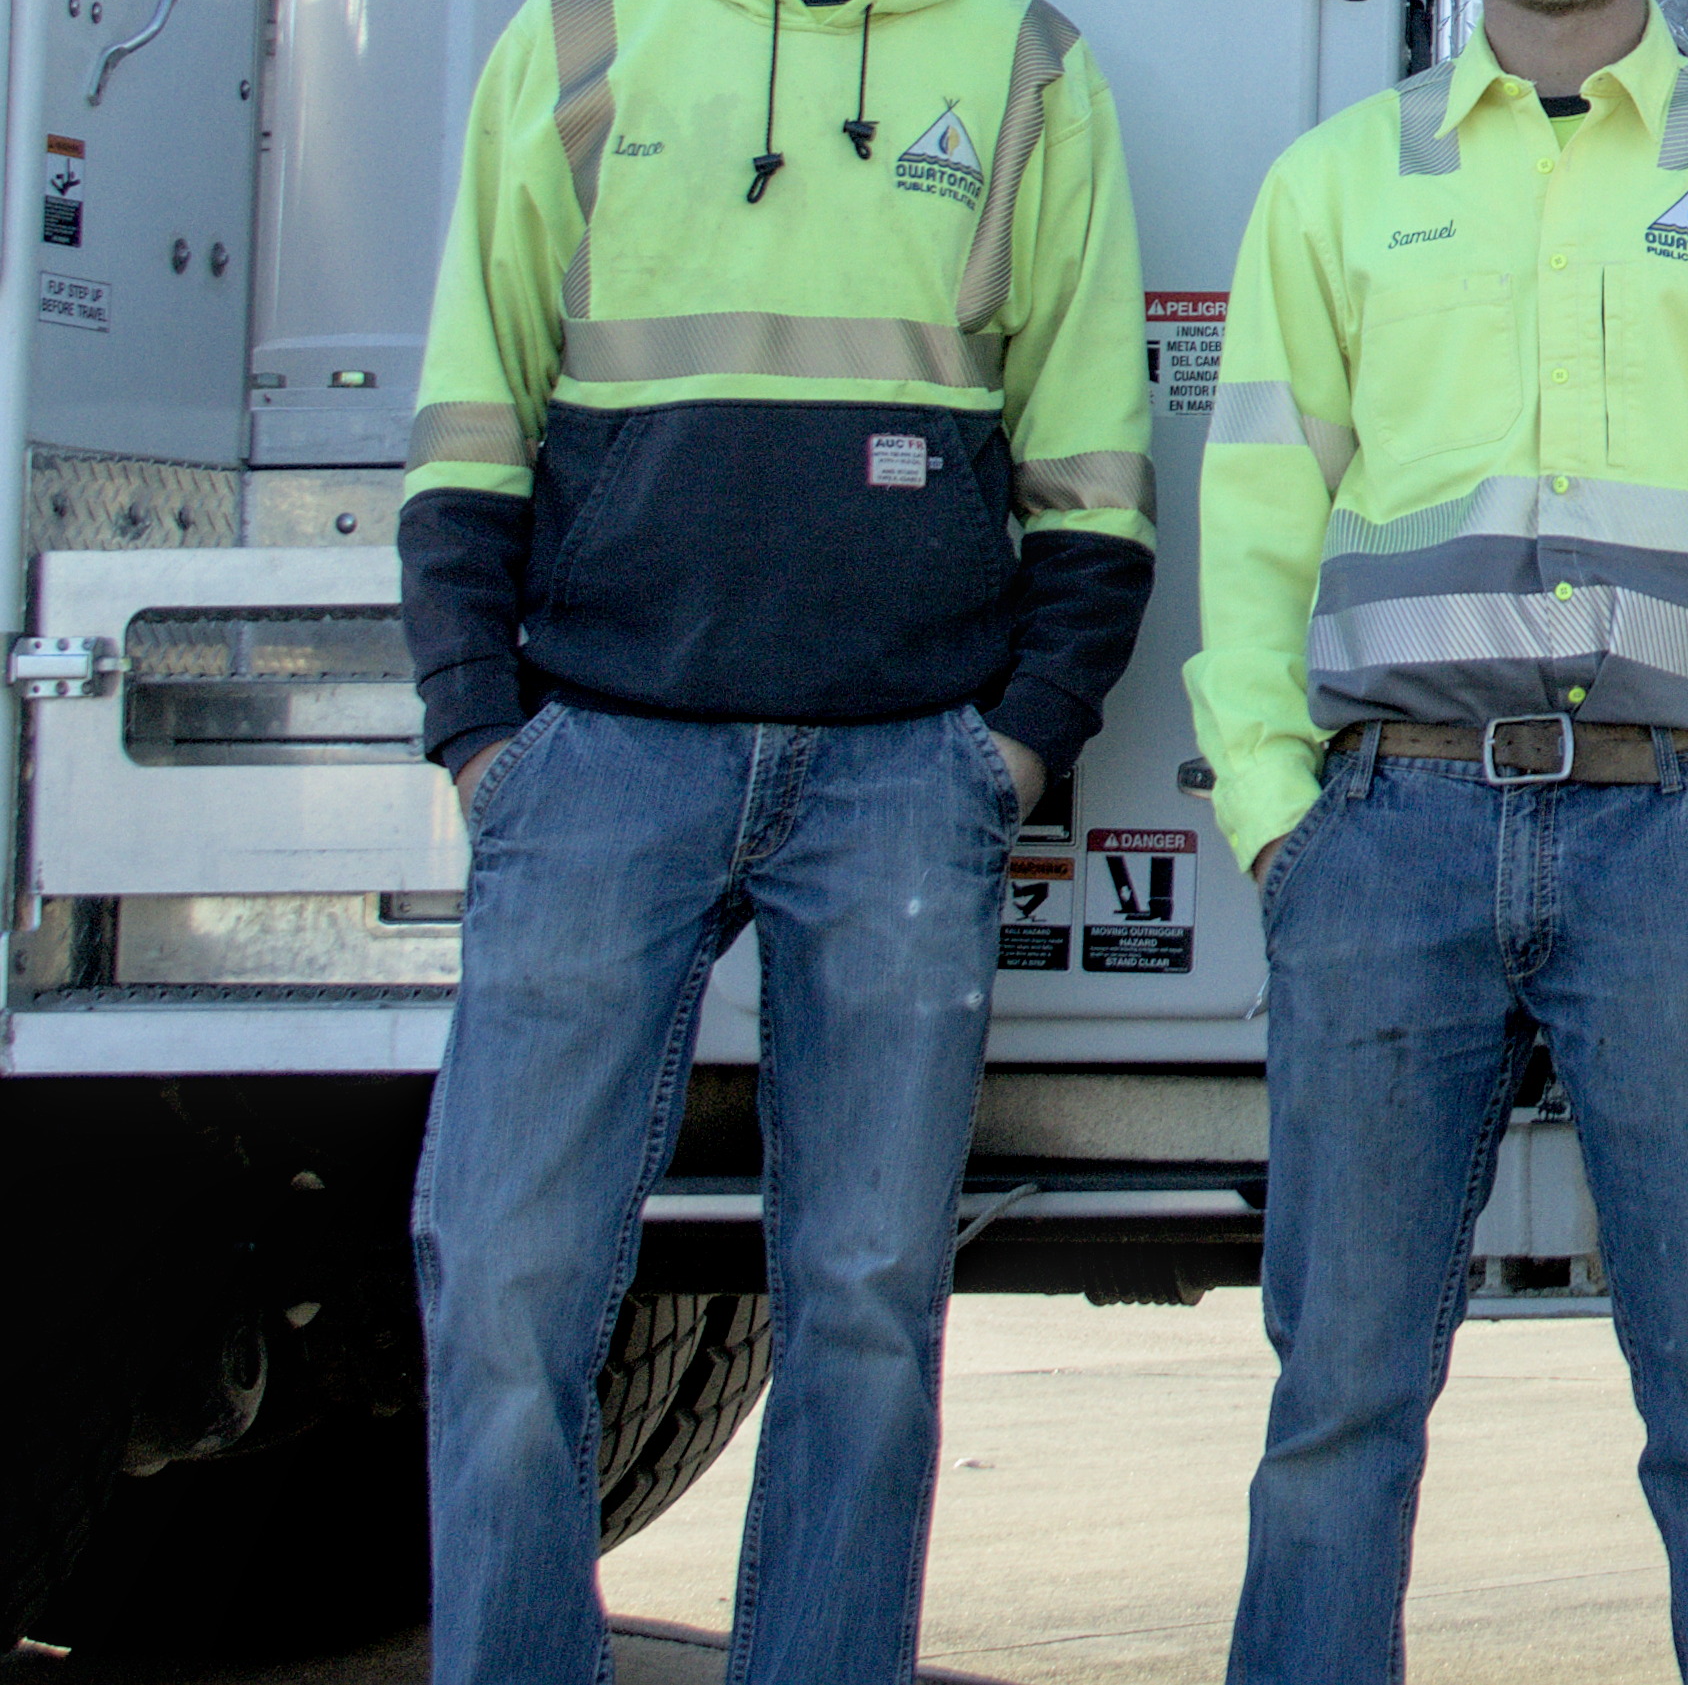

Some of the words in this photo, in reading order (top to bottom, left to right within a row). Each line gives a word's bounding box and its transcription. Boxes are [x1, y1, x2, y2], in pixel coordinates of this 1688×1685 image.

[614, 135, 665, 157] Lance
[895, 163, 982, 198] OWATONNA
[897, 180, 937, 194] PUBLIC
[1387, 219, 1457, 249] Samuel
[1646, 245, 1688, 262] PUBLIC
[69, 283, 89, 299] STEP
[92, 288, 104, 302] UP
[42, 297, 75, 316] BEFORE
[78, 303, 108, 322] TRAVEL
[1166, 301, 1228, 316] PELIGR
[1167, 340, 1197, 352] META
[1200, 340, 1222, 352] DEB
[1172, 355, 1192, 367] DEL
[1195, 355, 1220, 367] CAM
[1170, 385, 1209, 396] MOTOR
[1169, 400, 1184, 411] EN
[1187, 400, 1213, 411] MAR
[1121, 833, 1186, 848] DANGER
[1090, 927, 1129, 937] MOVING
[1130, 927, 1185, 937] OUTRIGGER
[1118, 938, 1158, 947] HAZARD
[1105, 957, 1137, 966] STAND
[1138, 957, 1170, 966] CLEAR
